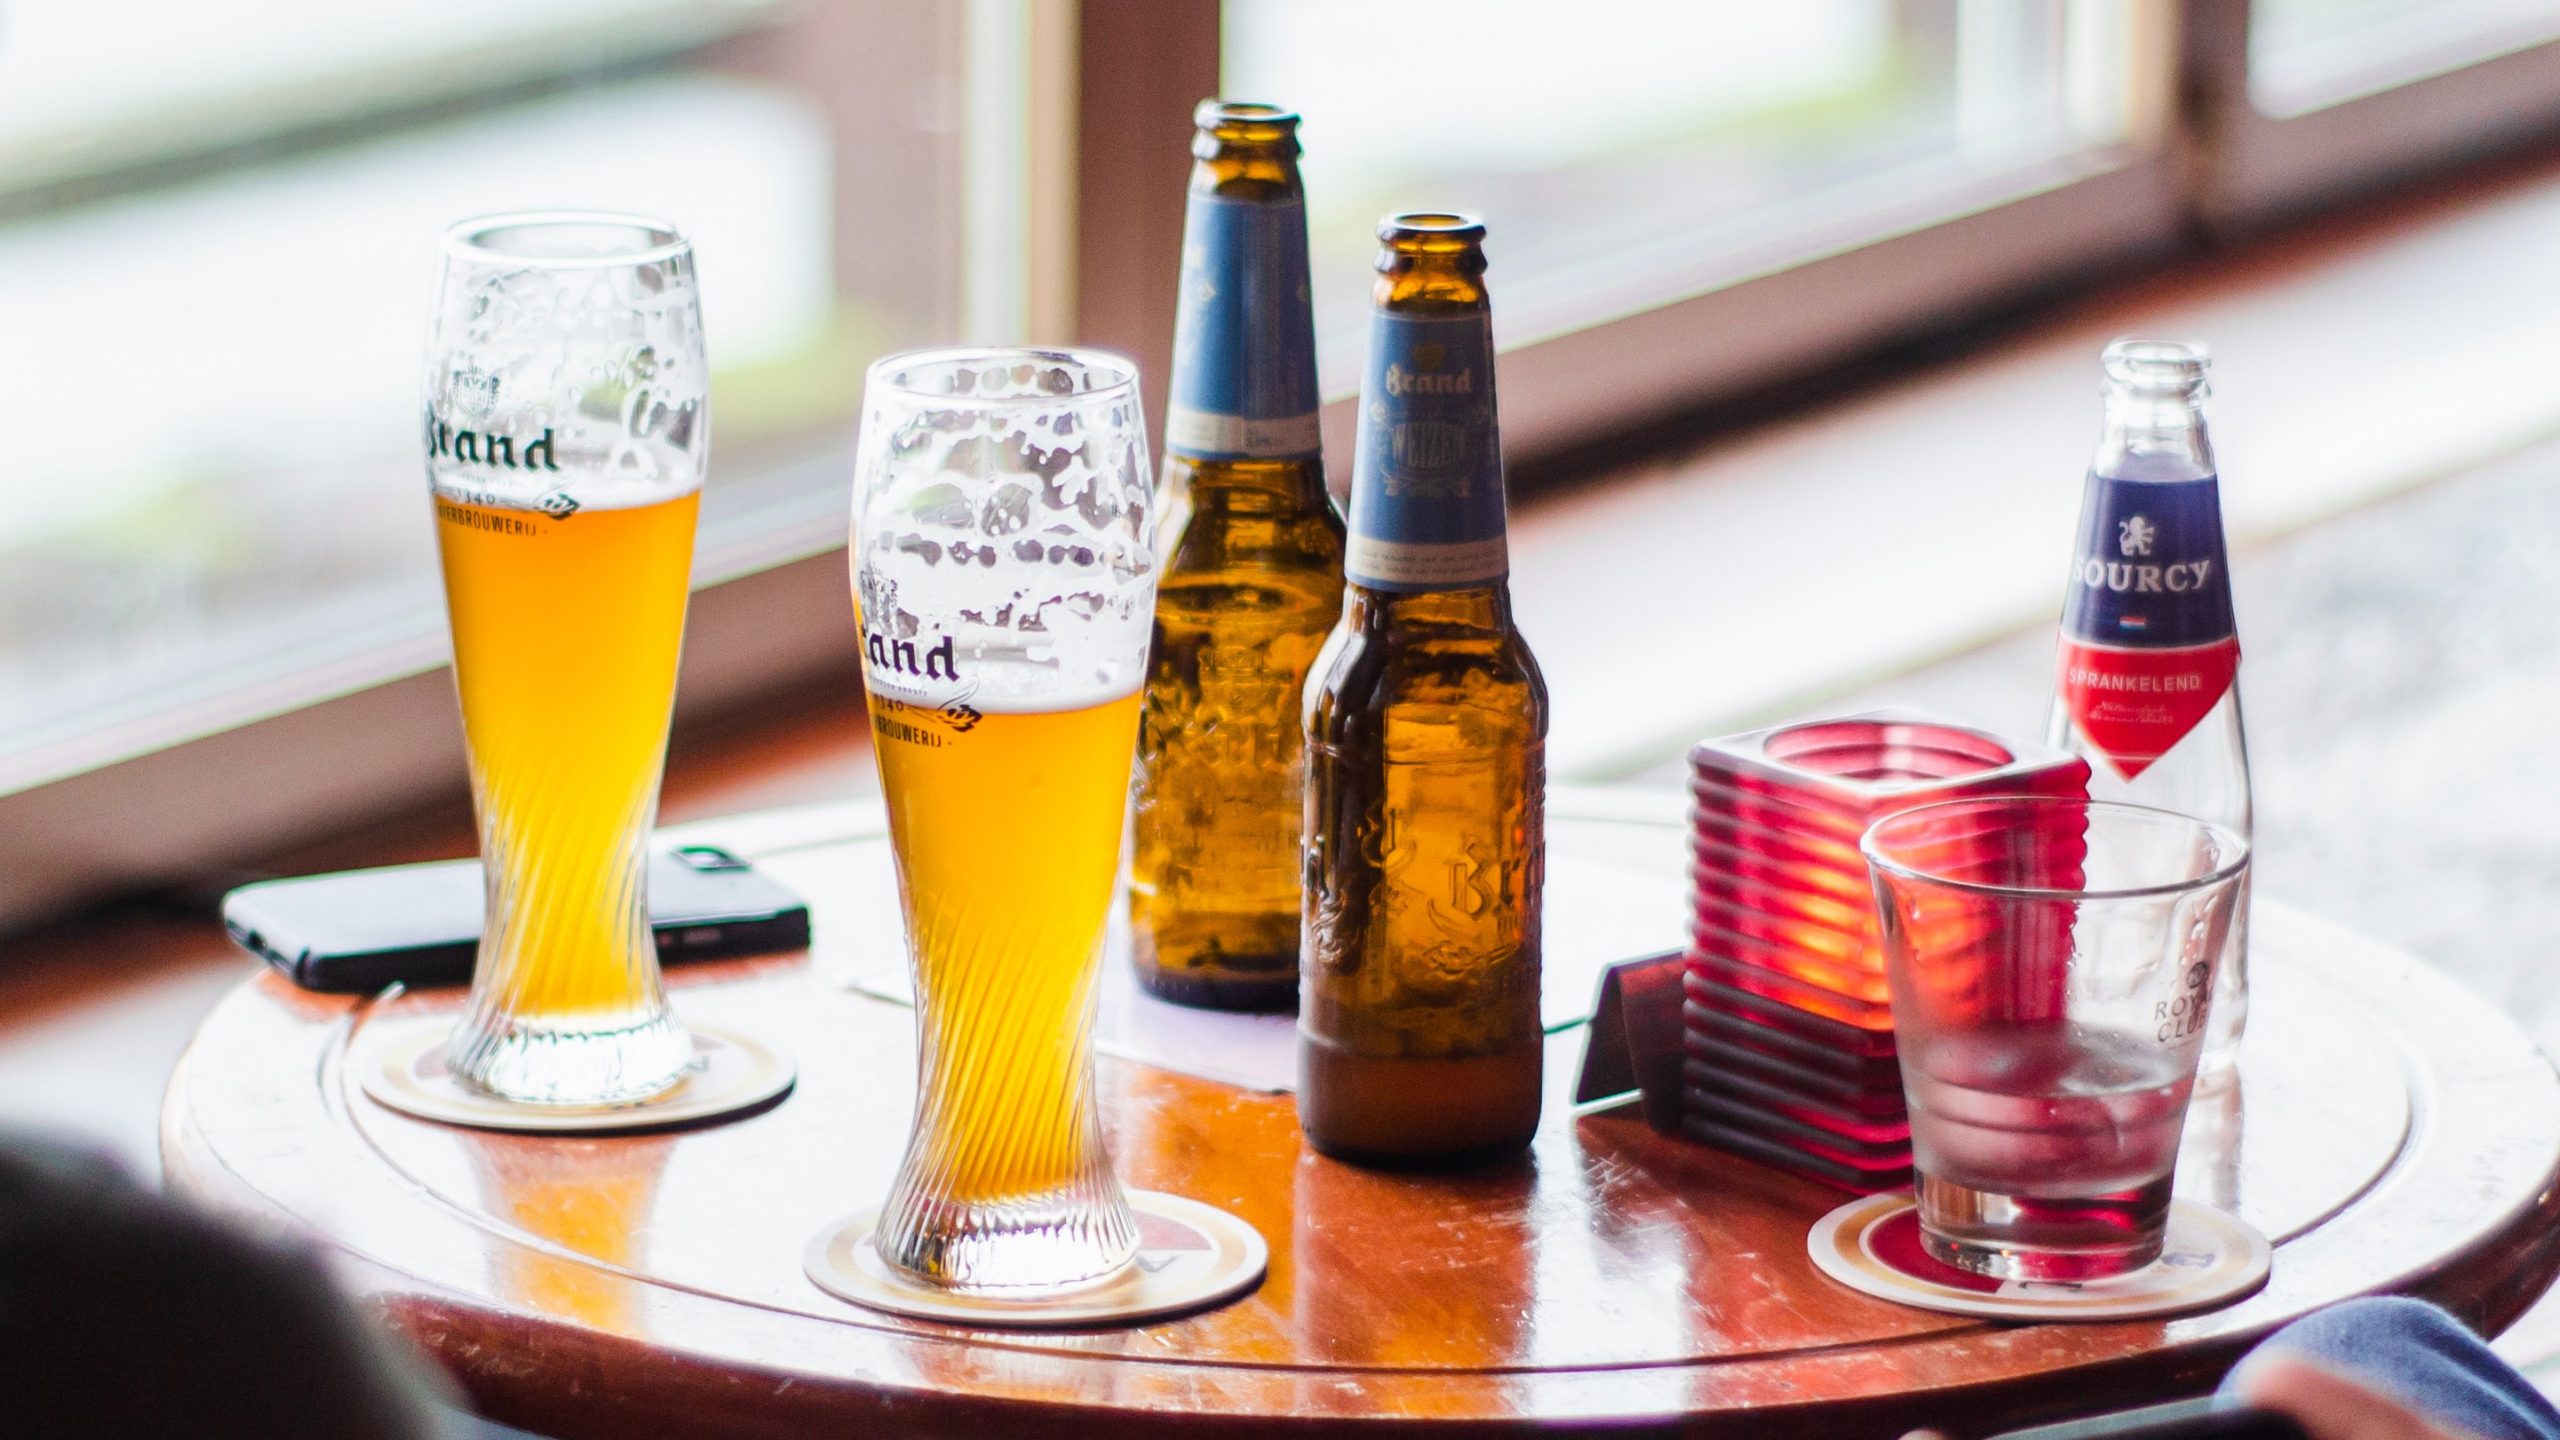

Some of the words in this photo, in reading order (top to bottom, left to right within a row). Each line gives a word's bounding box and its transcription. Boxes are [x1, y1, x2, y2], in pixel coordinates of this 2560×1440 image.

[1386, 364, 1472, 396] Brand
[2073, 555, 2211, 593] SOURCY
[2069, 668, 2202, 692] SPRANKELEND
